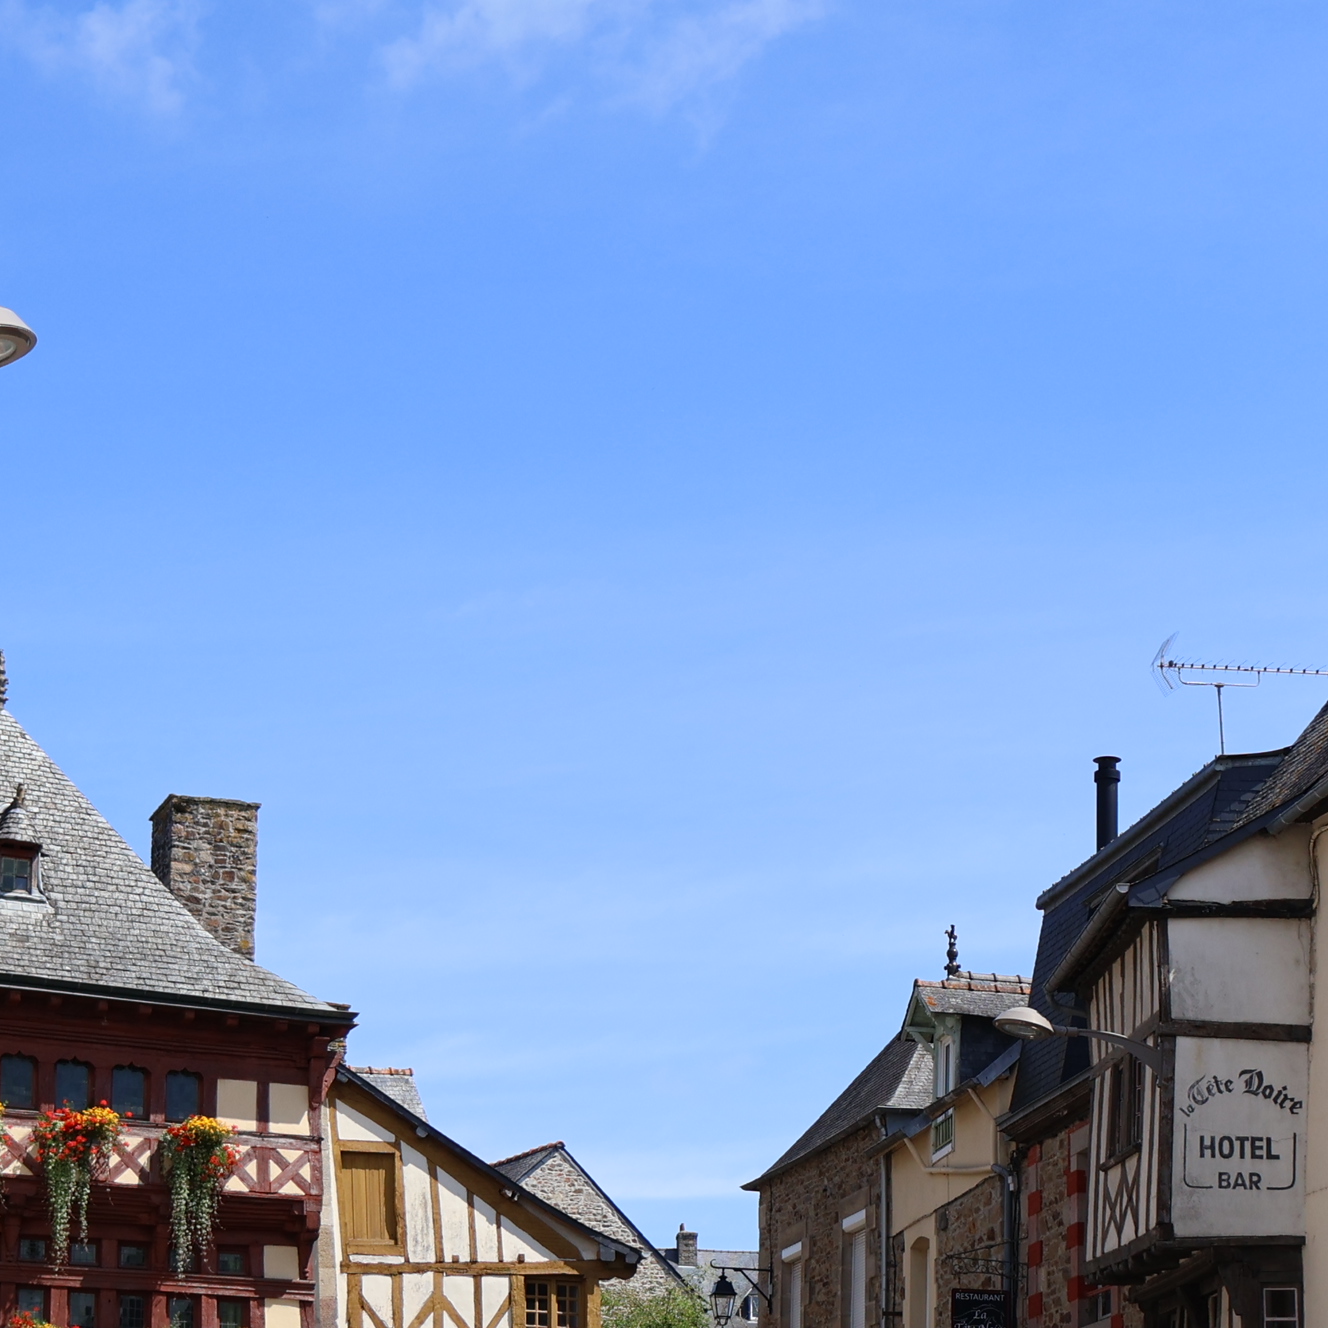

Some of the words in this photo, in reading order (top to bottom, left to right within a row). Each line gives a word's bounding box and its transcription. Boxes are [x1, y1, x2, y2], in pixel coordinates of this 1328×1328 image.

[1187, 1074, 1234, 1106] Tête
[1199, 1135, 1281, 1160] HOTEL
[1217, 1171, 1262, 1190] BAR
[955, 1292, 1005, 1302] RESTAURANT
[973, 1310, 987, 1319] La
